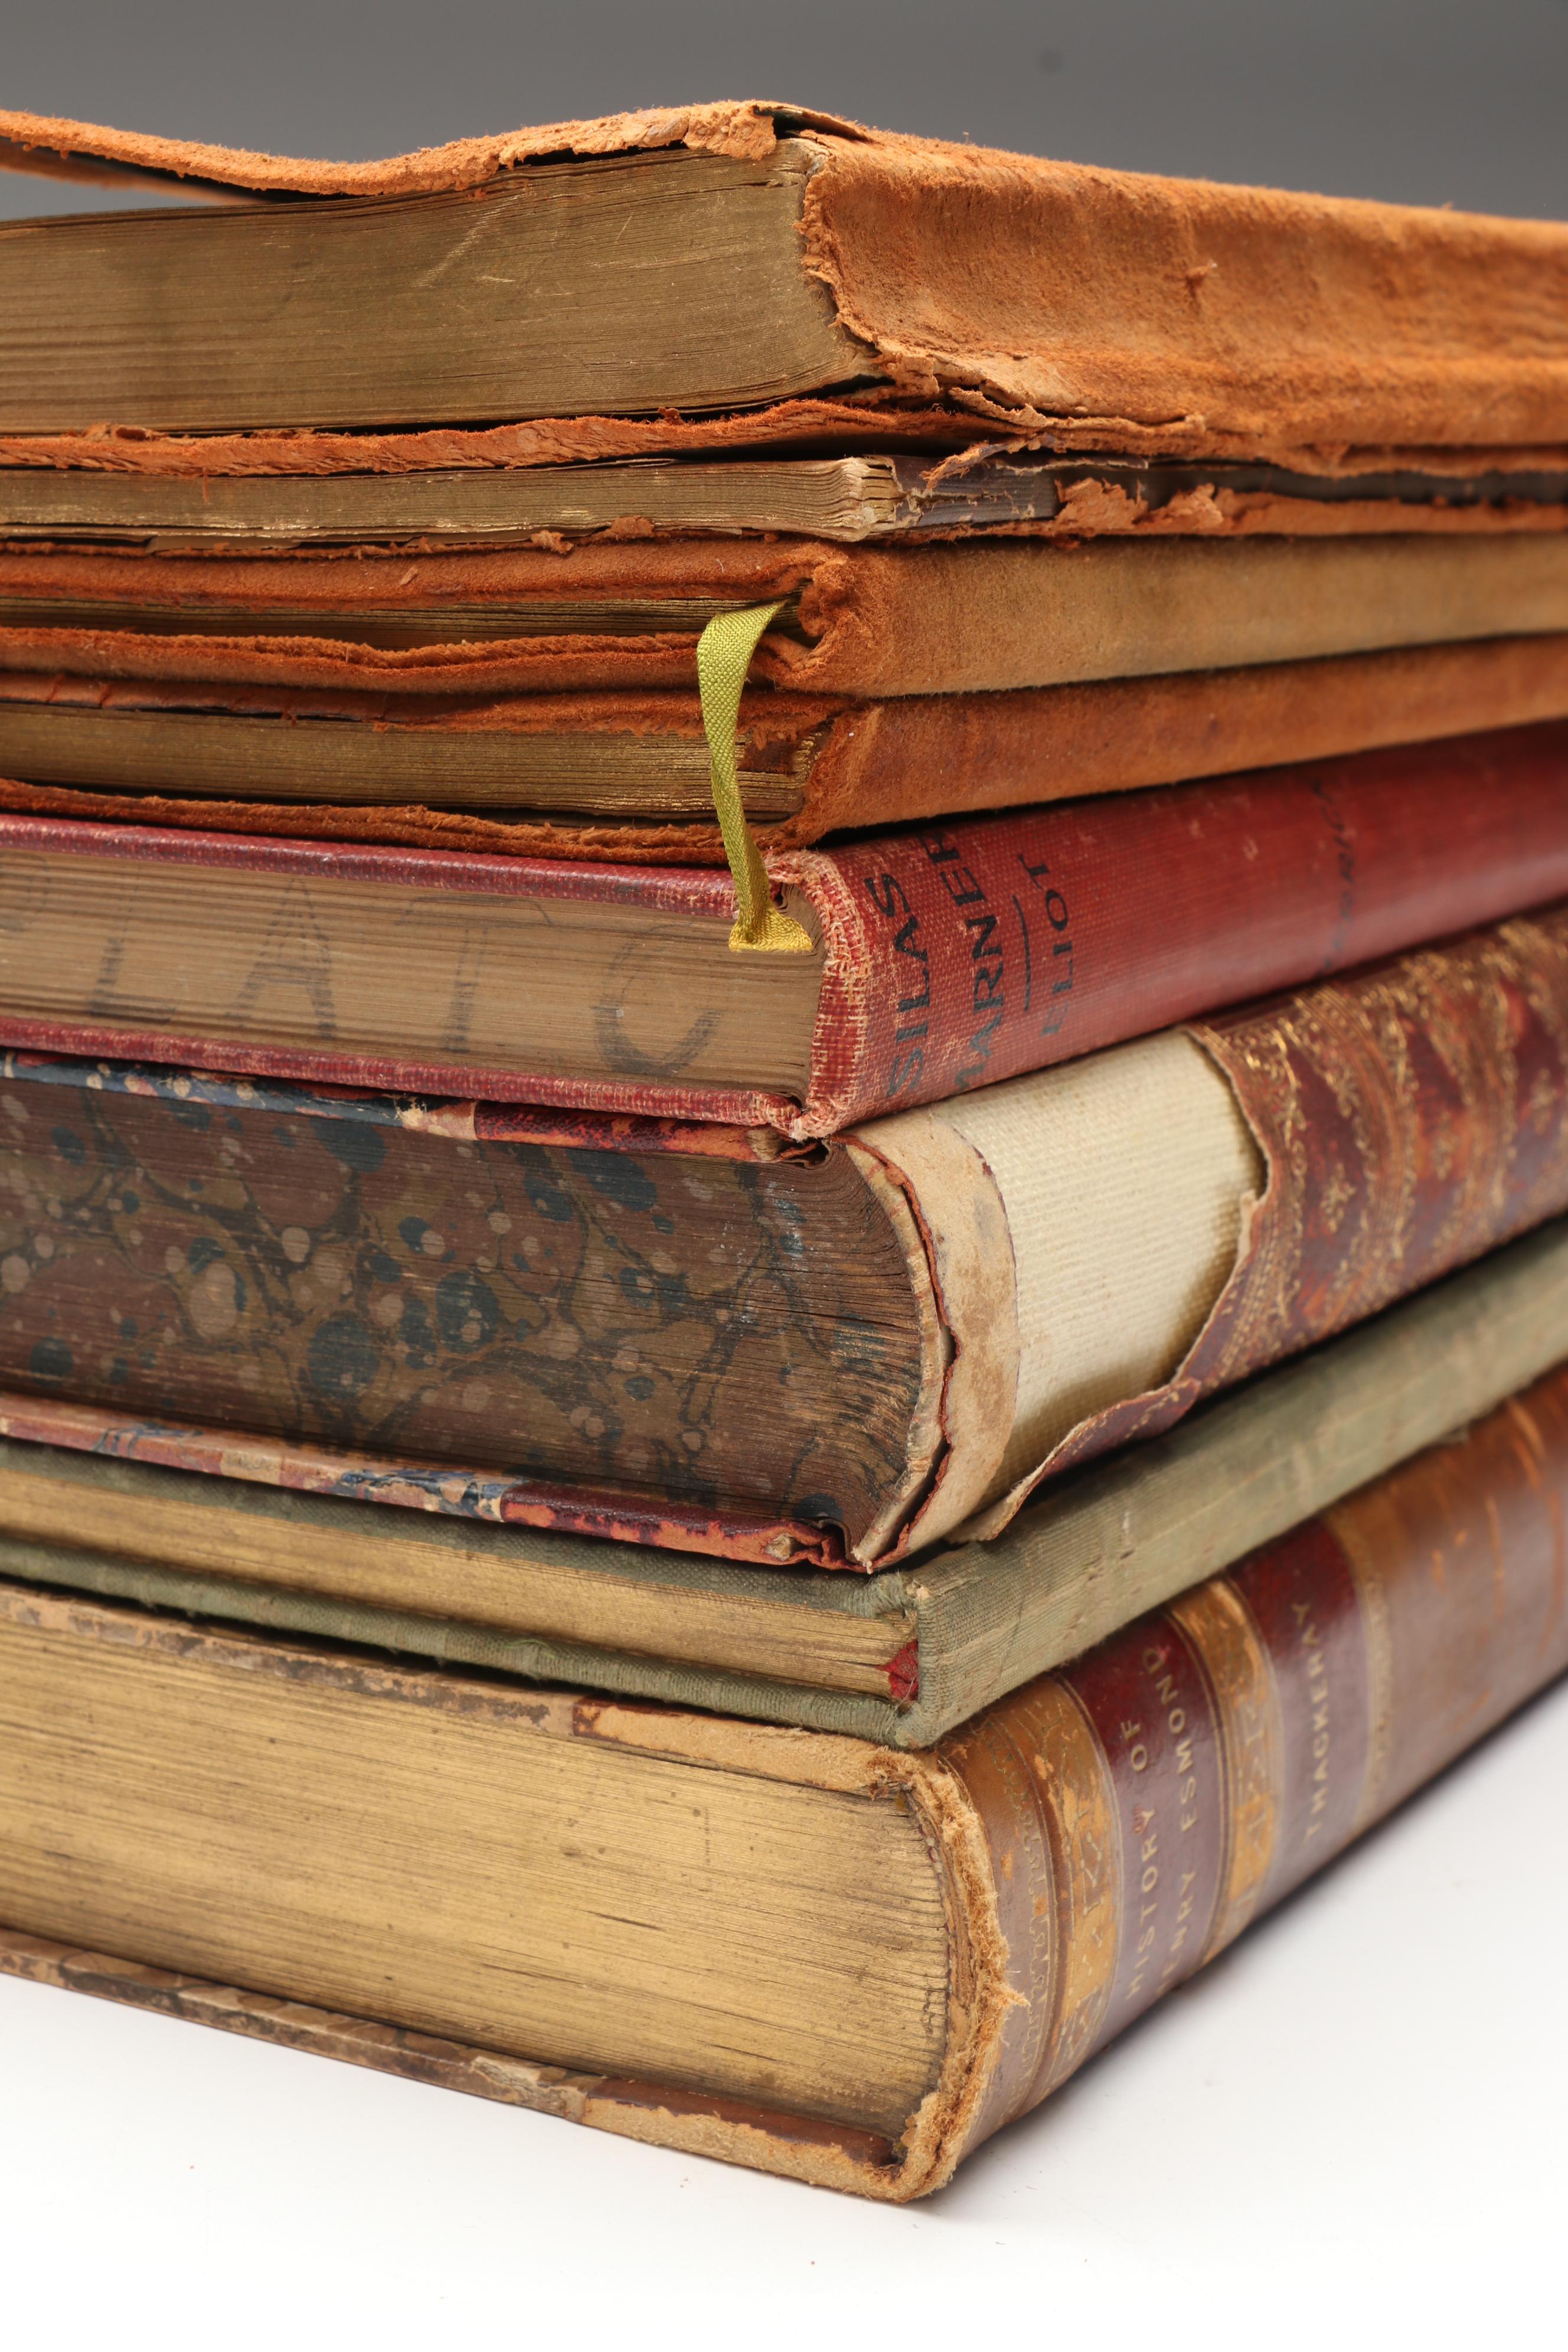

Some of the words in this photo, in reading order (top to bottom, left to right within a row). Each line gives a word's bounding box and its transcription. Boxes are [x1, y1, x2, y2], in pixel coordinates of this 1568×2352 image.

[864, 873, 930, 1096] SILAS
[1018, 853, 1073, 1038] ELIOT
[1121, 1719, 1148, 1772] OF
[1142, 1647, 1197, 1833] ESMOND
[1292, 1602, 1330, 1843] THACKERAY
[1125, 1808, 1158, 2000] HISTORY
